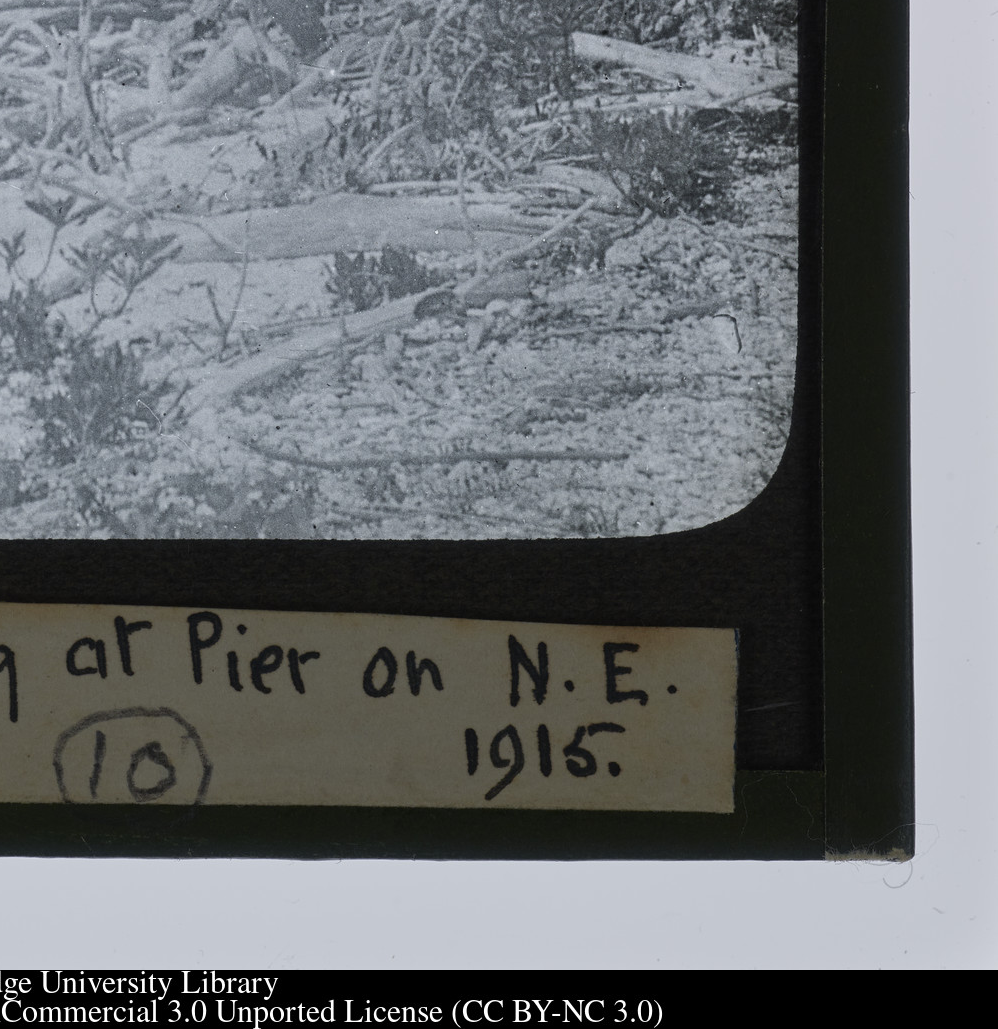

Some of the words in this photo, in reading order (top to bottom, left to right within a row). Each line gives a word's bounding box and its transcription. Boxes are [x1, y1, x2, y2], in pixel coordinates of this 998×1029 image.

[65, 616, 153, 679] at
[187, 612, 320, 695] Pier
[362, 646, 444, 698] on
[464, 722, 626, 802] 1915.
